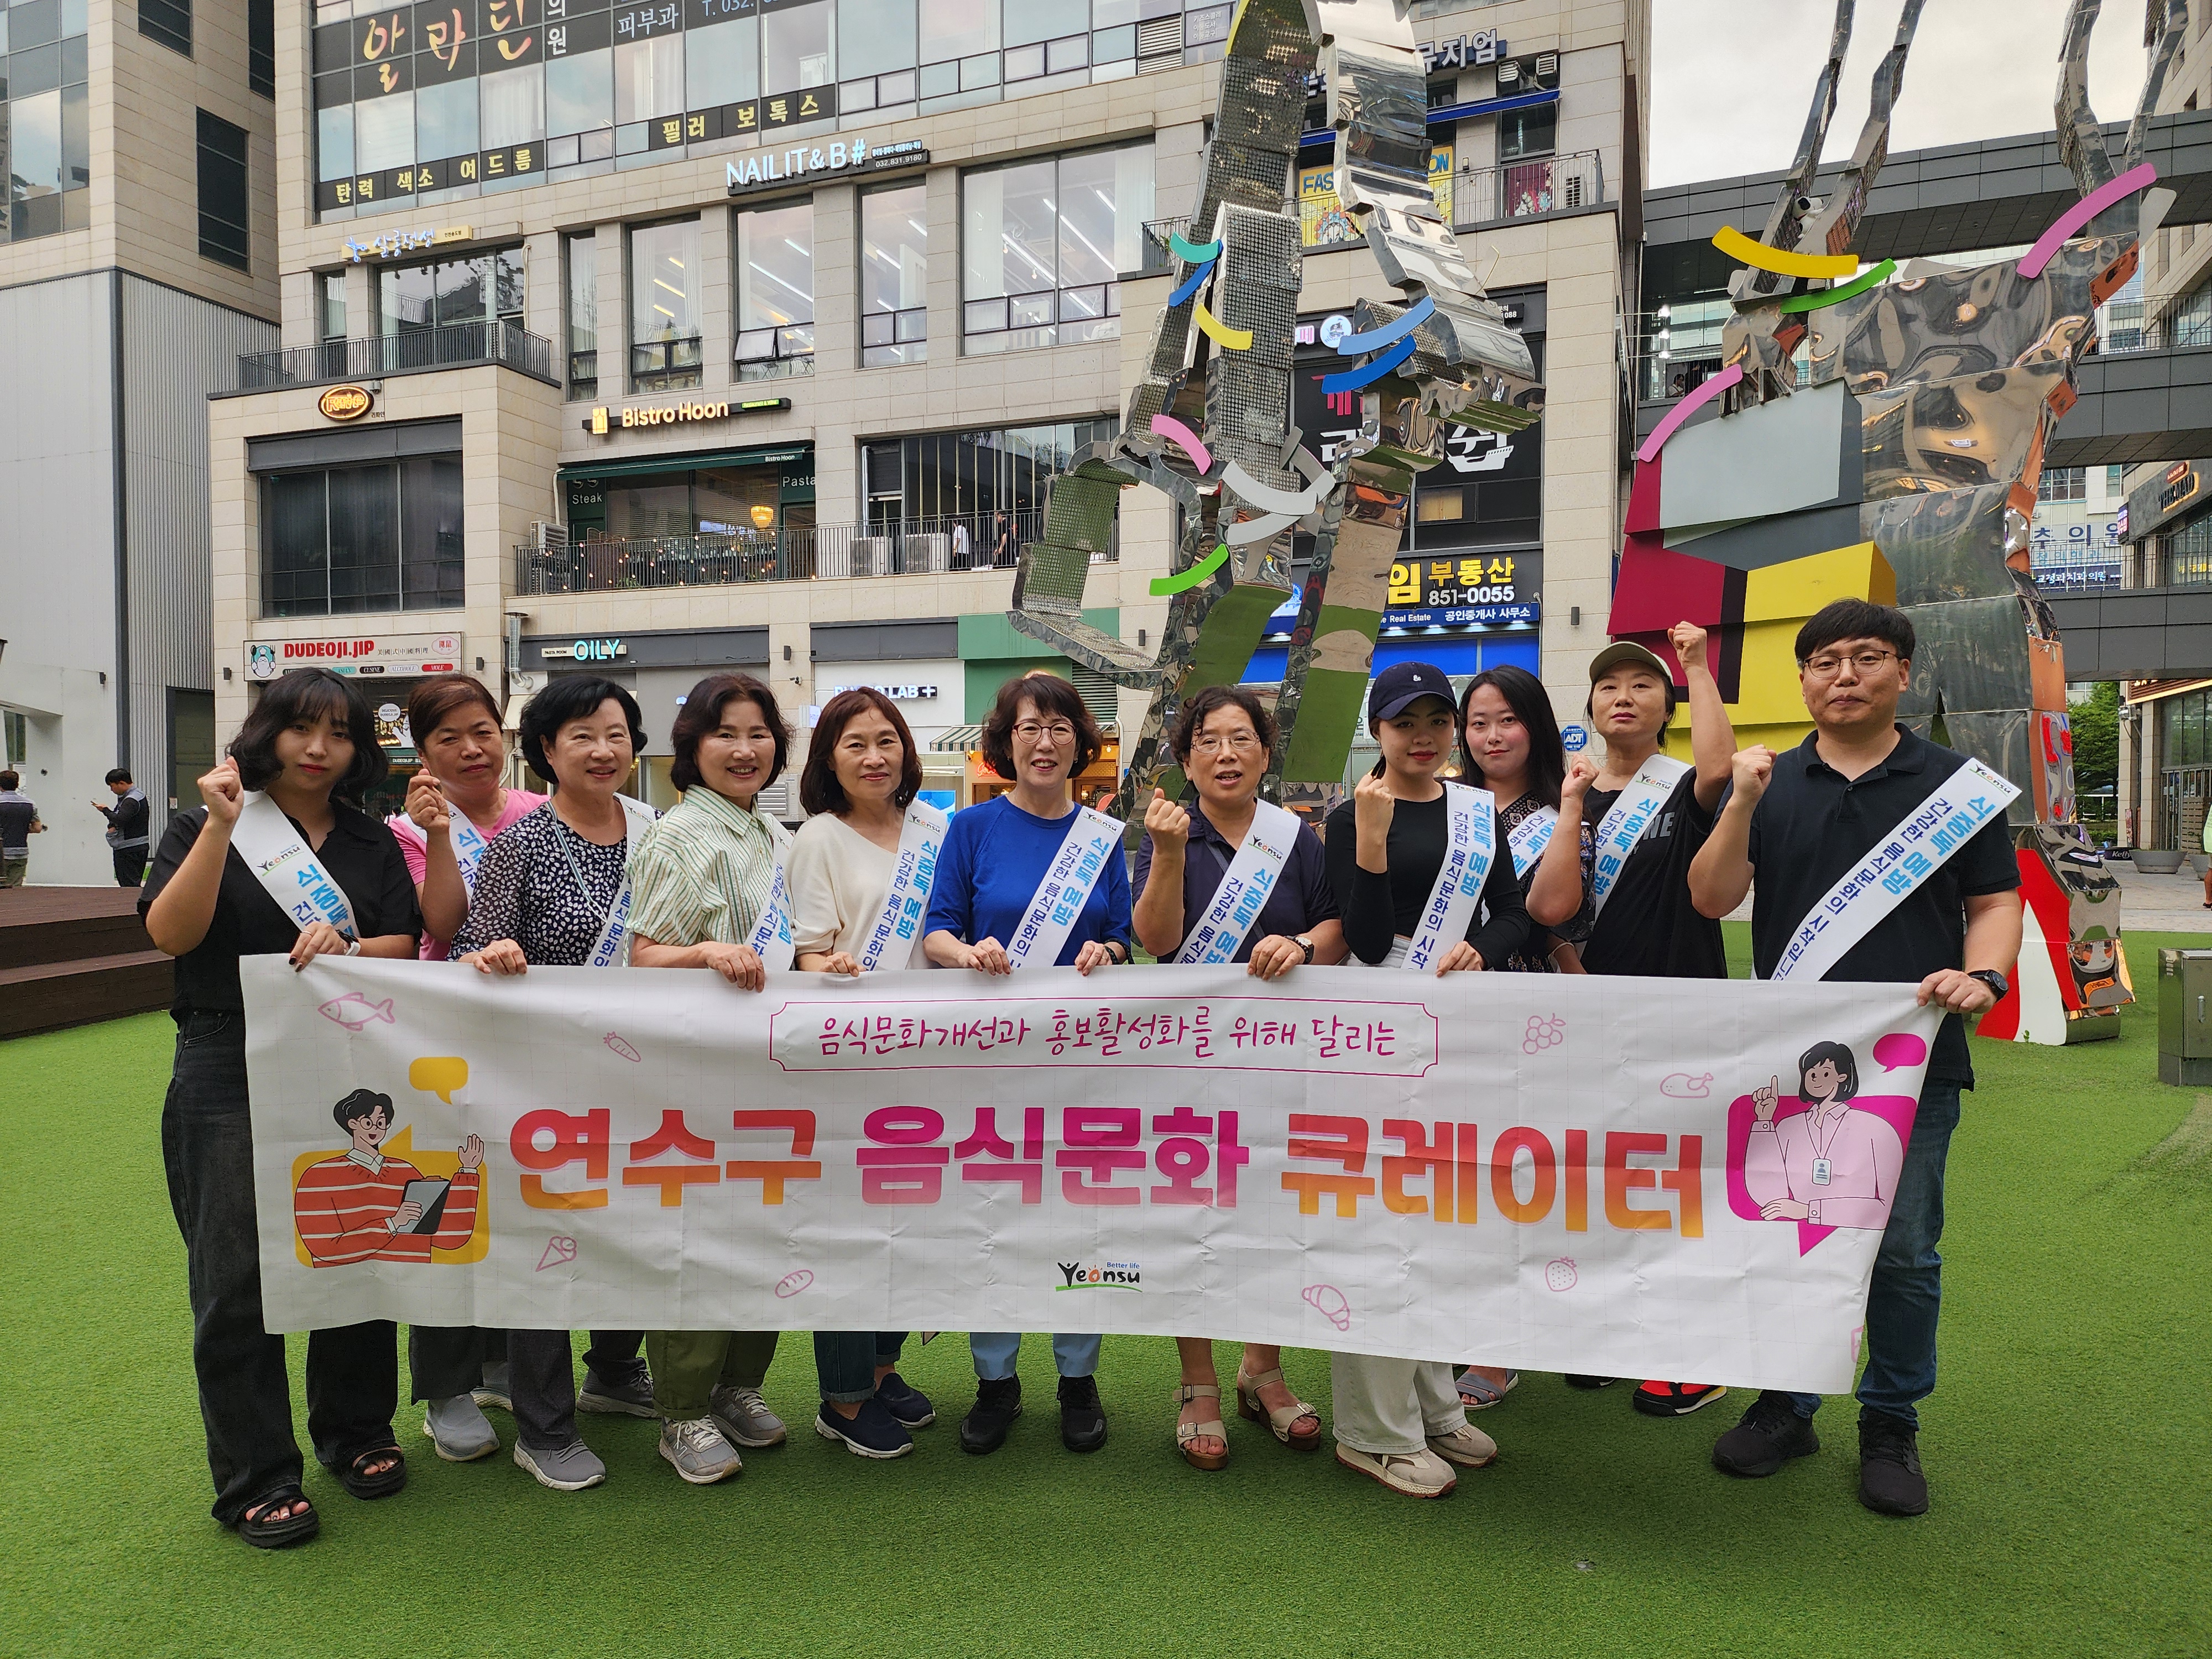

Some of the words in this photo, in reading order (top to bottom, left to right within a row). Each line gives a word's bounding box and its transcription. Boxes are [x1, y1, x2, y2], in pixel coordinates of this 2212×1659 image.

[618, 3, 679, 38] 피부과
[663, 117, 705, 144] 필러
[737, 95, 820, 128] 보톡스
[336, 179, 373, 204] 탄력
[397, 168, 434, 192] 색소
[461, 149, 532, 180] 여드름
[622, 406, 676, 428] Bistro
[679, 400, 728, 421] Hoon
[572, 493, 603, 505] Steak
[782, 476, 816, 488] Pasta
[1427, 556, 1515, 586] 부동산
[1428, 585, 1515, 607] 851-0055
[1444, 608, 1496, 622] 공인중개사
[1499, 607, 1531, 619] 사무소
[284, 640, 374, 659] DUDEOJI.JIP
[573, 639, 620, 661] OILY
[888, 685, 919, 699] LAB
[1564, 733, 1583, 743] ADT
[1641, 773, 1672, 791] Yeonsu
[1975, 764, 2011, 794] Yeonsu
[910, 812, 941, 833] Yeonsu
[1086, 811, 1118, 832] Yeonsu
[1453, 811, 1469, 847] 건강한
[1472, 801, 1491, 850] 식중독
[1613, 798, 1660, 853] 식중독
[1900, 797, 1953, 844] 건강한
[1929, 796, 1996, 858] 식중독
[257, 846, 301, 872] Yeonsu
[1052, 841, 1082, 881] 건강한
[1074, 836, 1110, 888] 식중독
[1253, 833, 1282, 860] Yeonsu
[893, 848, 915, 892] 건강한
[913, 839, 938, 896] 식중독
[1459, 851, 1489, 898] 예방
[1824, 841, 1906, 915] 음식문화의
[1881, 851, 1933, 895] 예방
[1051, 886, 1084, 927] 예방
[1209, 877, 1244, 925] 건강한
[1232, 868, 1274, 931] 식중독
[1424, 848, 1466, 932] 음식문화의
[862, 893, 902, 972] 음식문화의
[895, 897, 923, 940] 예방
[1013, 882, 1061, 957] 음식문화의
[819, 1016, 1031, 1056] 음식문화개선과
[1045, 1006, 1214, 1059] 홍보활성화를
[1229, 1016, 1296, 1050] 위해
[1312, 1016, 1396, 1058] 달리는
[510, 1108, 822, 1211] 연수구
[857, 1106, 1250, 1207] 음식문화
[1281, 1113, 1704, 1238] 큐레이터
[1057, 1261, 1140, 1287] Yeonsu
